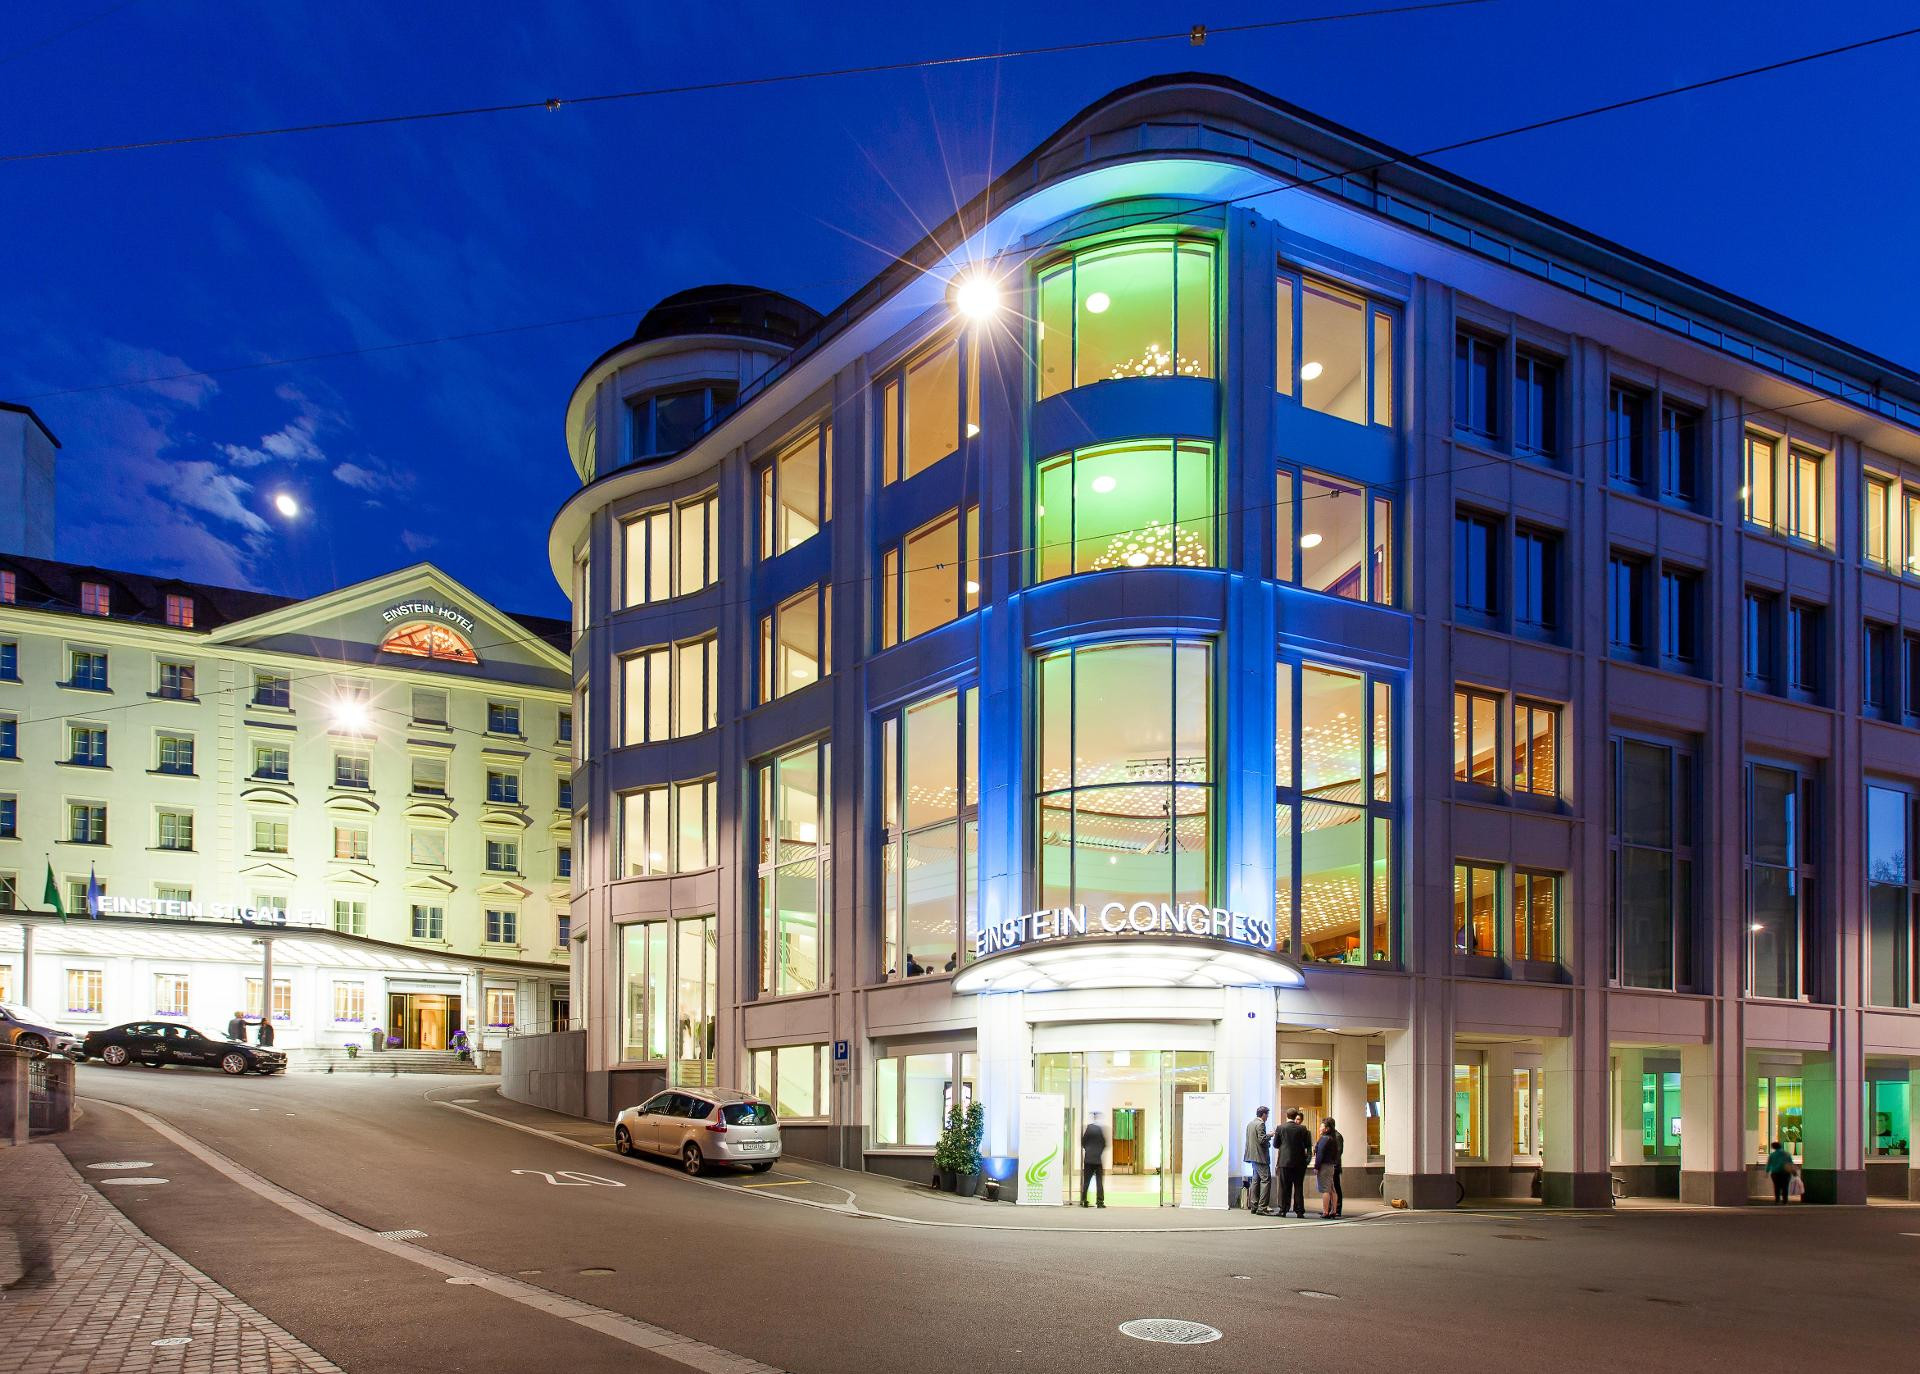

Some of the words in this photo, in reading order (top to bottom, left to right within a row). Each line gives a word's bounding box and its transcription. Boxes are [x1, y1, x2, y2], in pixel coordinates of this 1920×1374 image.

[382, 604, 434, 622] EINSTEIN
[438, 607, 475, 633] HOTEL
[97, 895, 203, 918] EINSTEIN
[976, 903, 1087, 958] EINSTEIN
[1100, 901, 1273, 948] CONGRESS
